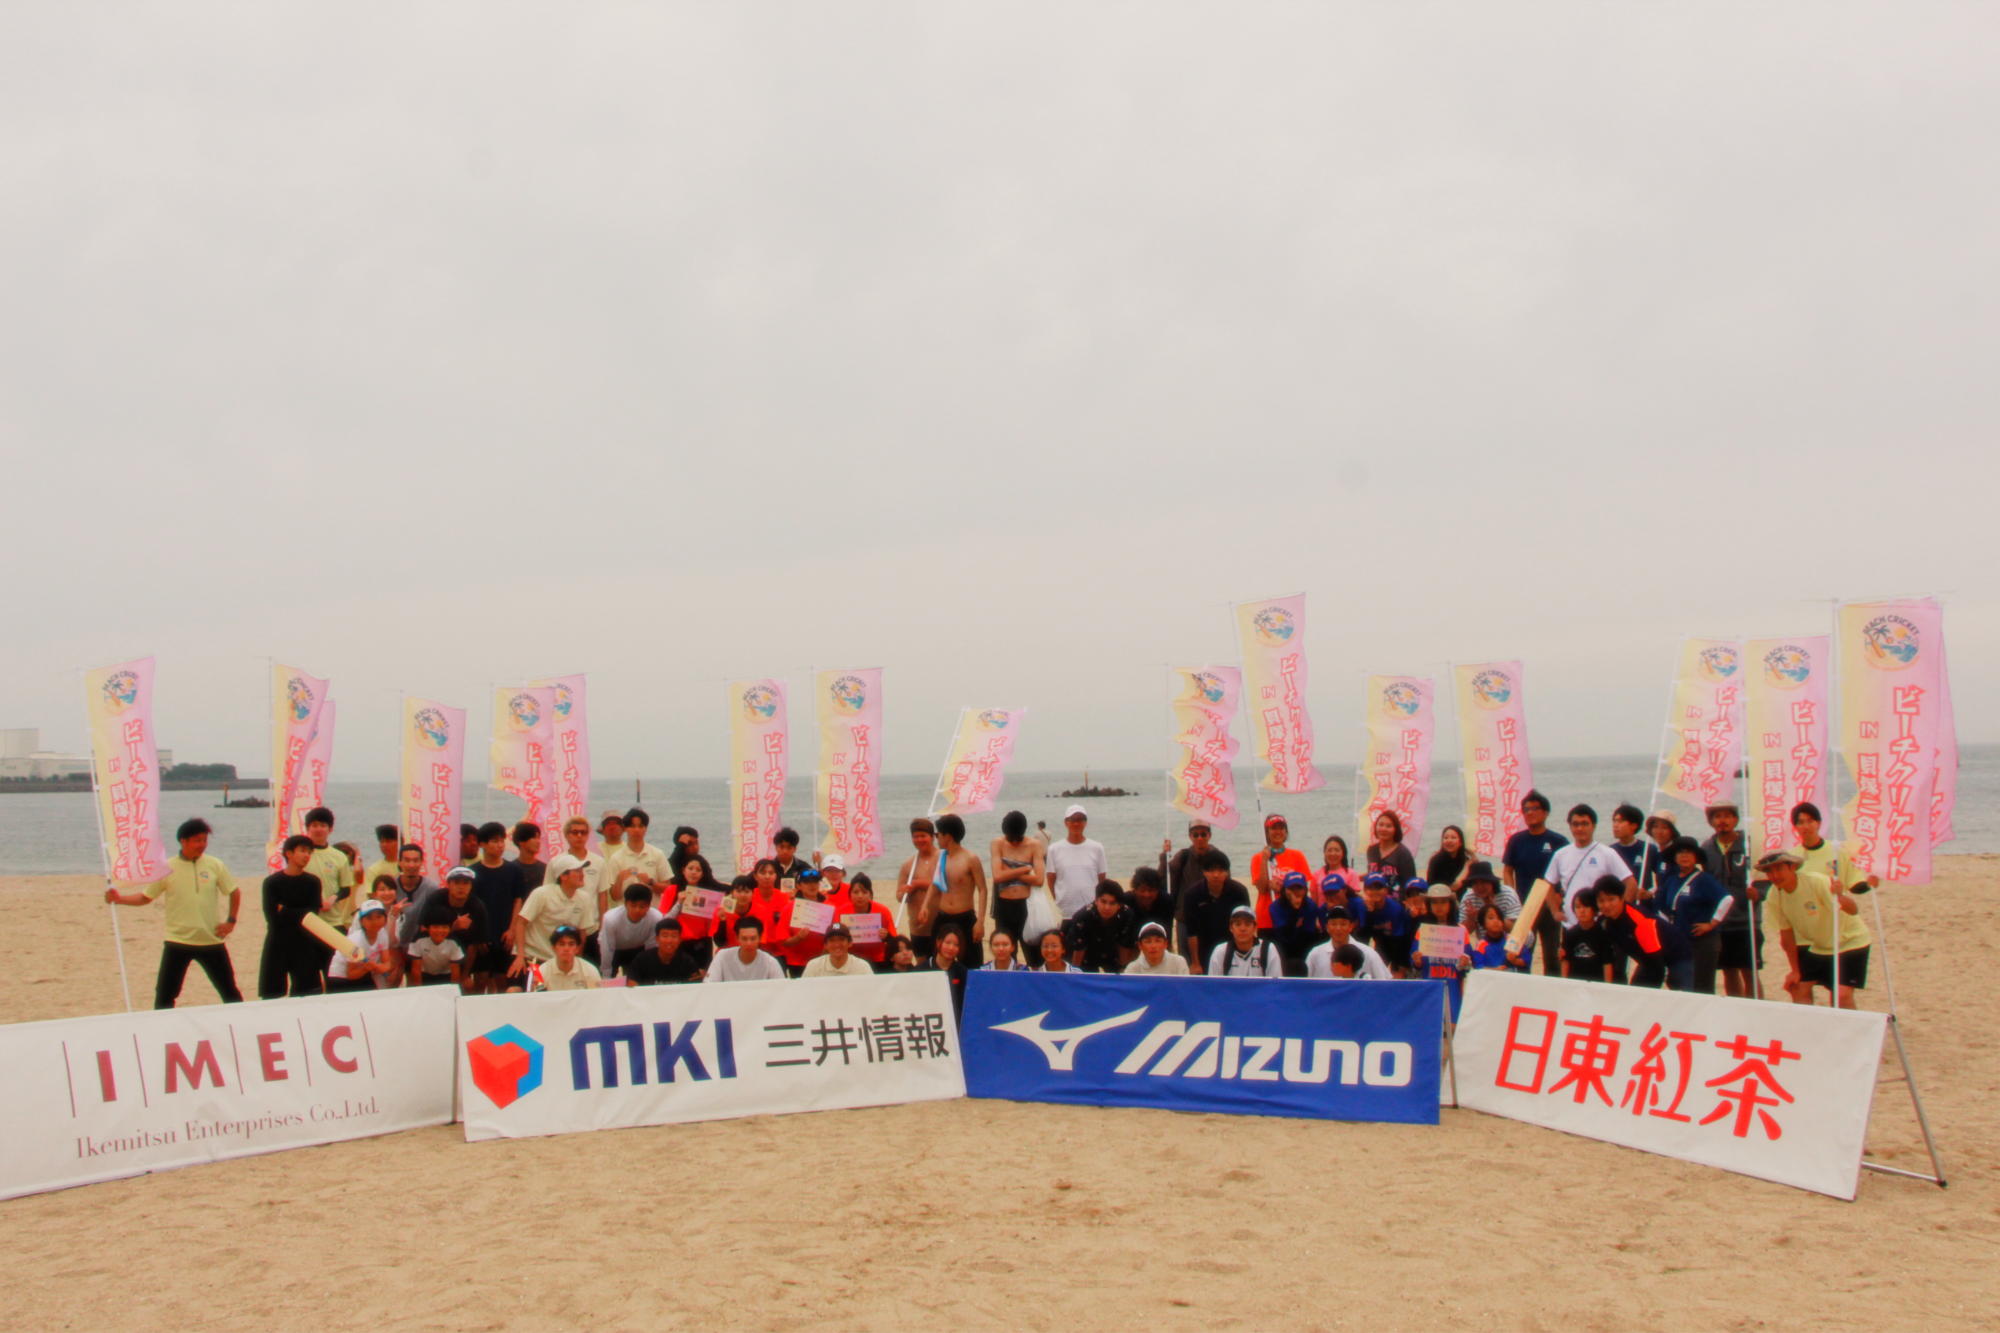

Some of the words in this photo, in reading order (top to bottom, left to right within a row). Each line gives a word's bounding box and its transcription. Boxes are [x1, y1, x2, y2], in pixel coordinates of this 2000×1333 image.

[1268, 606, 1293, 620] CRICKET
[1862, 614, 1886, 635] BEACH
[1886, 614, 1919, 636] CRICKET
[1763, 646, 1783, 663] BEACH
[1783, 645, 1810, 660] CRICKET
[846, 675, 867, 689] CRICKET
[1487, 669, 1511, 683] CRICKET
[759, 685, 780, 698] CRICKET
[1261, 685, 1276, 699] IN
[1399, 682, 1422, 698] CRICKET
[1685, 706, 1702, 719] IN
[1858, 721, 1878, 739] IN
[1762, 733, 1781, 748] IN
[832, 753, 847, 766] IN
[1376, 752, 1391, 765] IN
[1475, 747, 1489, 761] IN
[502, 766, 517, 780] IN
[743, 760, 757, 773] IN
[1885, 684, 1926, 881] ビーチクリケット
[763, 1012, 950, 1068] 三井情報
[1495, 1006, 1801, 1141] 日東紅茶
[76, 1128, 178, 1159] Ikemitsu
[185, 1110, 304, 1139] Enterprises
